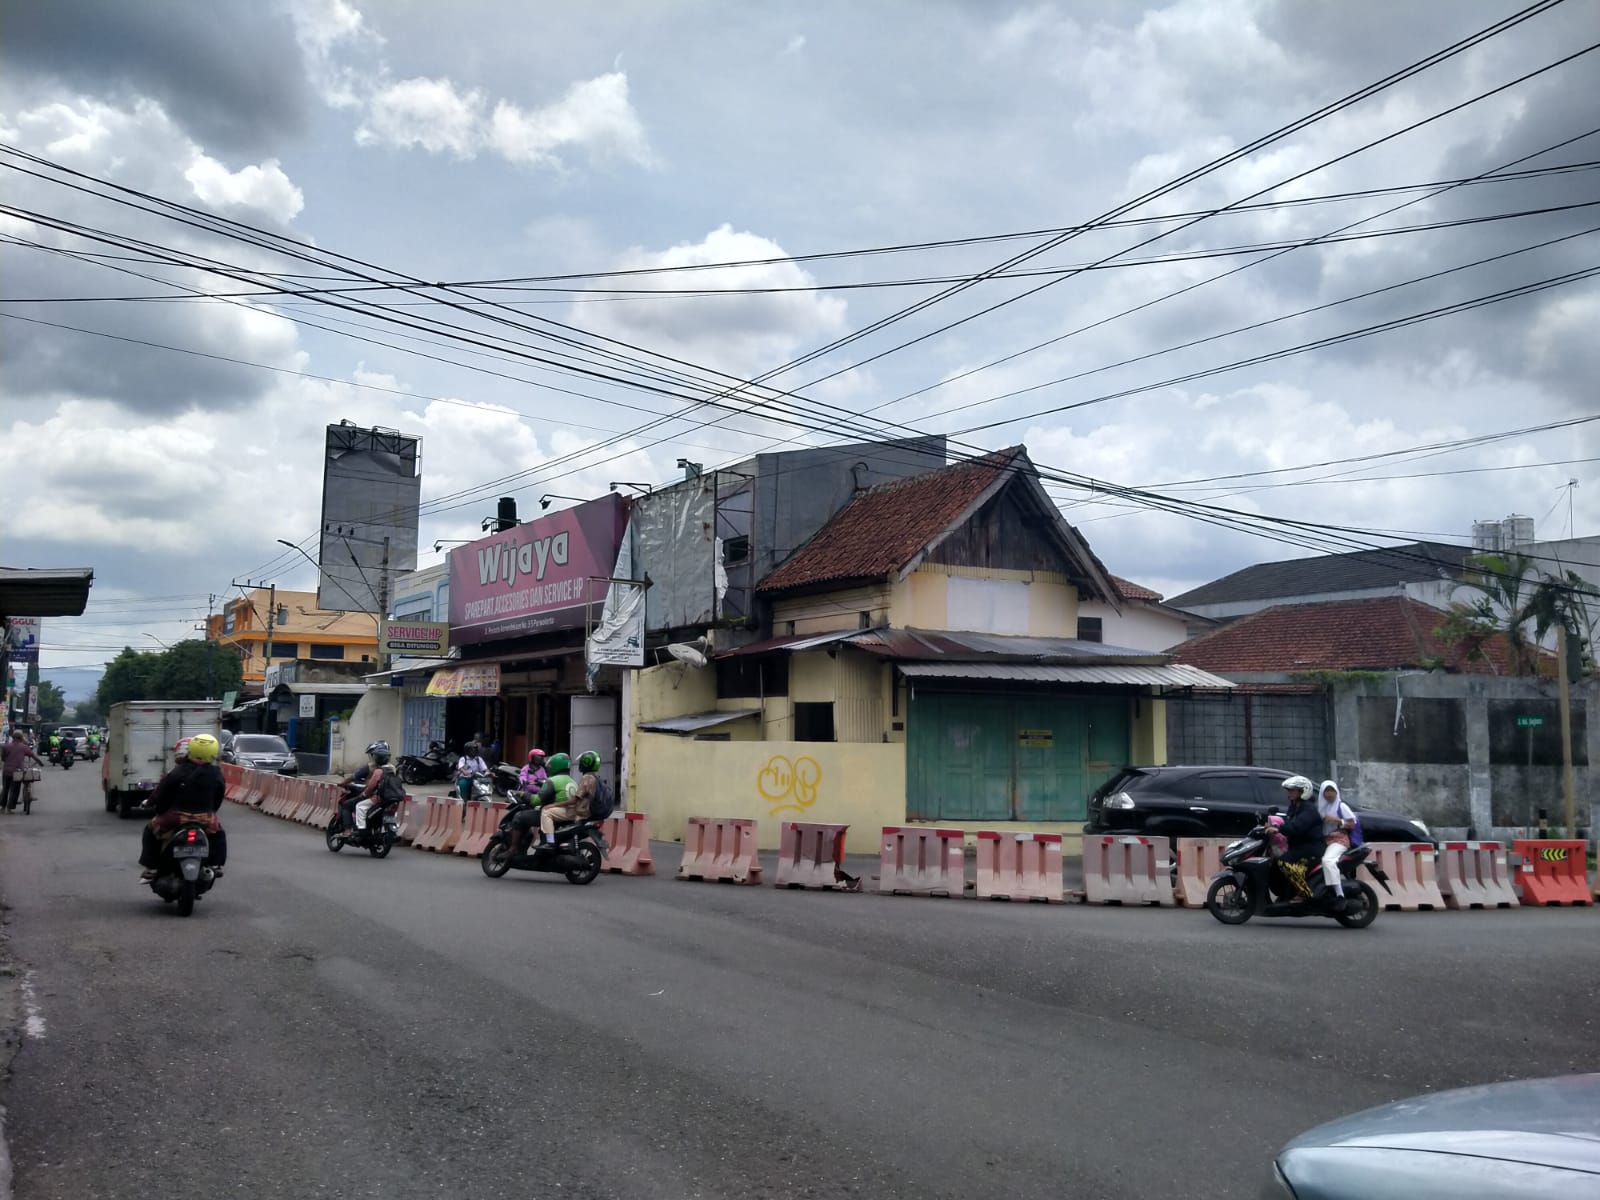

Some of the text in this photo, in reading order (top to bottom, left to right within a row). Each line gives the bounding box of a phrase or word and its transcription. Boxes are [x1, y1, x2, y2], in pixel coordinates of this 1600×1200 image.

[478, 531, 570, 588] Wijaya
[530, 585, 543, 606] DAN
[544, 579, 572, 605] SERVICE
[573, 577, 584, 599] HP
[428, 627, 442, 641] HP
